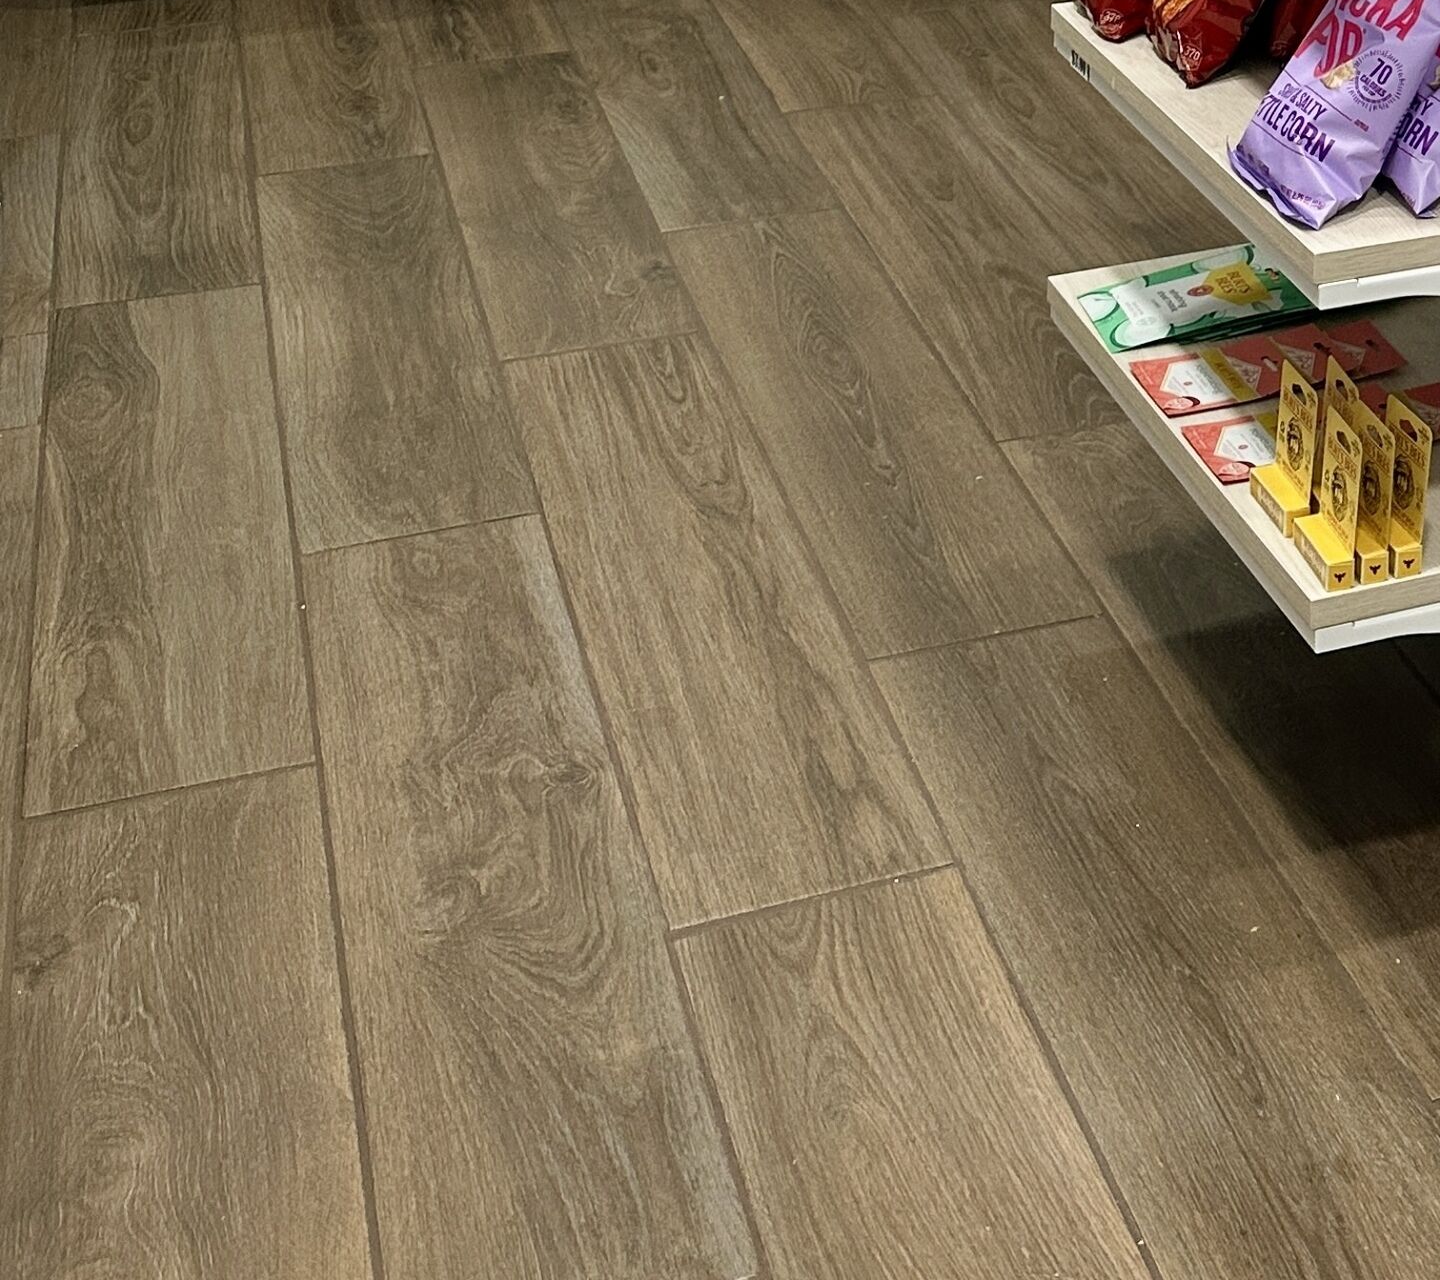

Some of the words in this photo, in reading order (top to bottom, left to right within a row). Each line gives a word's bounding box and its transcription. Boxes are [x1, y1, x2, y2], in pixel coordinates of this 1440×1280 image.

[1183, 45, 1201, 61] 370
[1367, 57, 1394, 86] 70
[1295, 89, 1328, 121] SALTY
[1280, 109, 1336, 163] CORN
